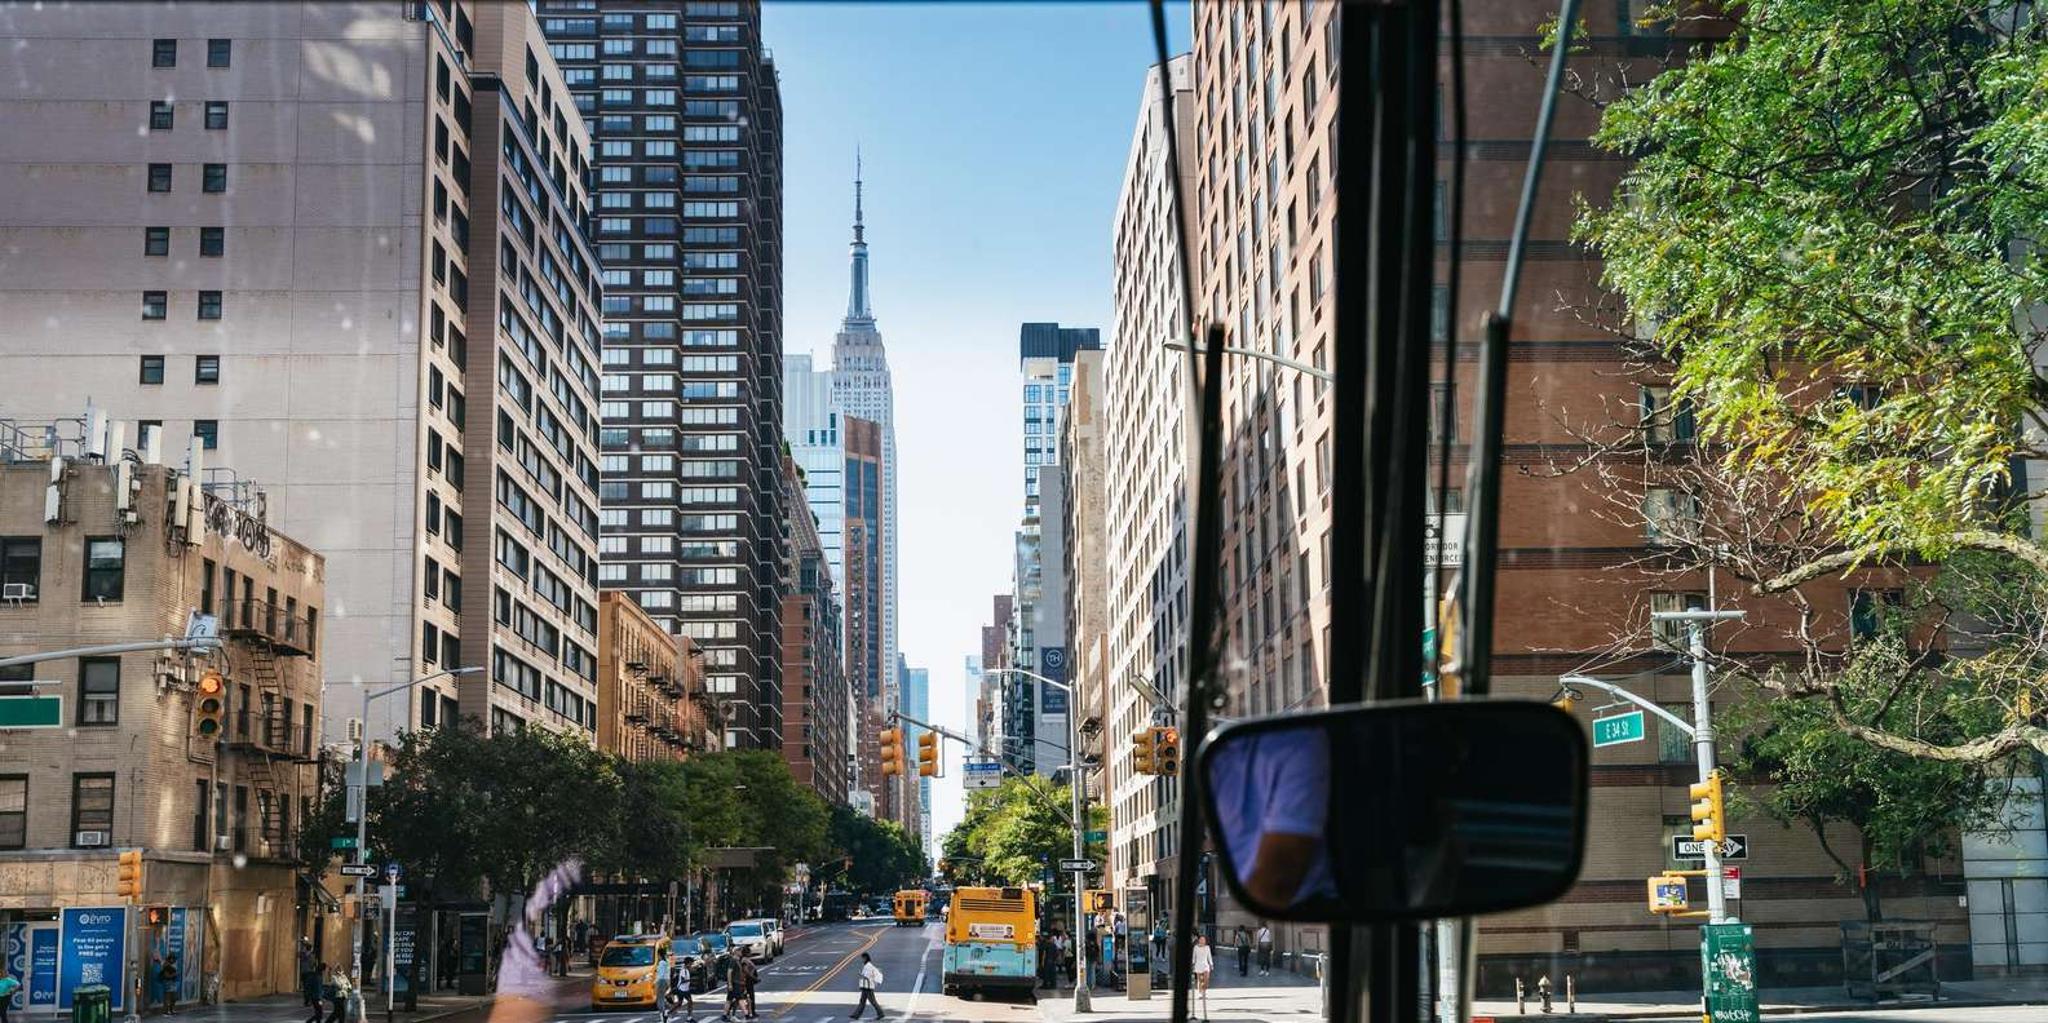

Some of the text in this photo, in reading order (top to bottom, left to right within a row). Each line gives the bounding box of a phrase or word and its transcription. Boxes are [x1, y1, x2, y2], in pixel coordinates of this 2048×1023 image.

[1605, 720, 1629, 739] E 34 St
[1684, 842, 1704, 852] ONE
